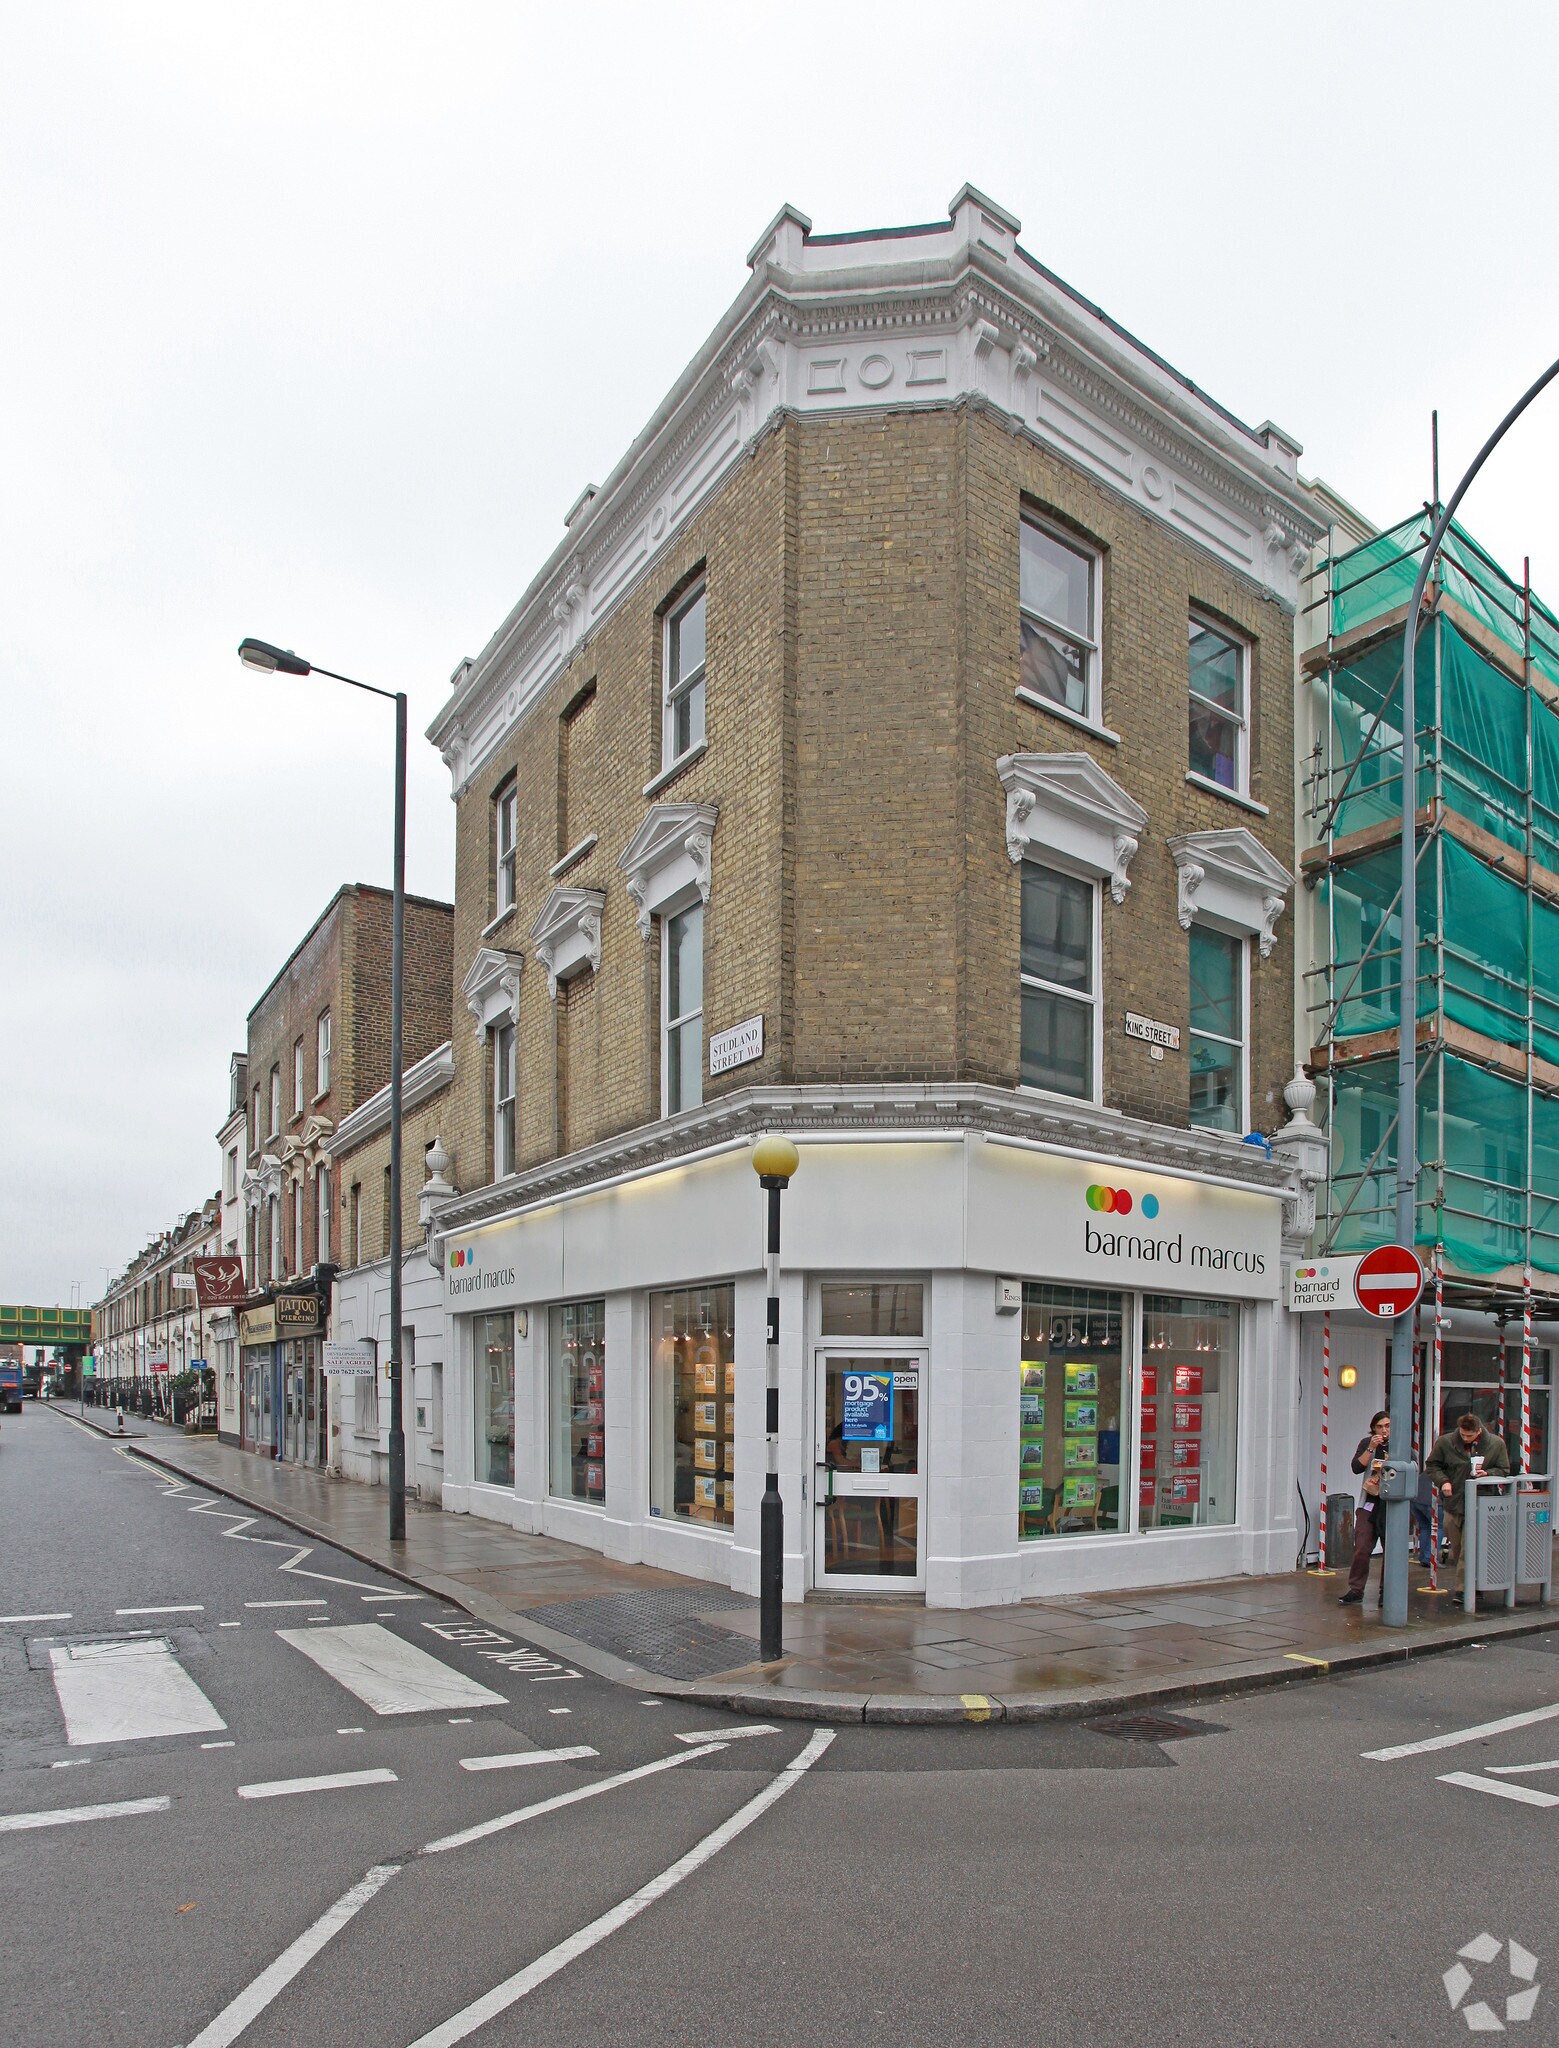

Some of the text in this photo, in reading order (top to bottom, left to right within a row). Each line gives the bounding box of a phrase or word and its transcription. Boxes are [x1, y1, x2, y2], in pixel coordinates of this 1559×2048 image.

[714, 1028, 758, 1057] STUDLAND
[1126, 1020, 1143, 1036] KING
[1145, 1026, 1171, 1044] STREET
[712, 1050, 744, 1072] STREET
[1086, 1220, 1265, 1274] barnard marcus
[450, 1267, 515, 1296] barnard marcus
[1294, 1278, 1340, 1292] barnard
[280, 1300, 315, 1313] TATTOO
[1294, 1293, 1334, 1304] marcus
[845, 1376, 888, 1401] 95%
[420, 1622, 584, 1682] LOOK LEFT
